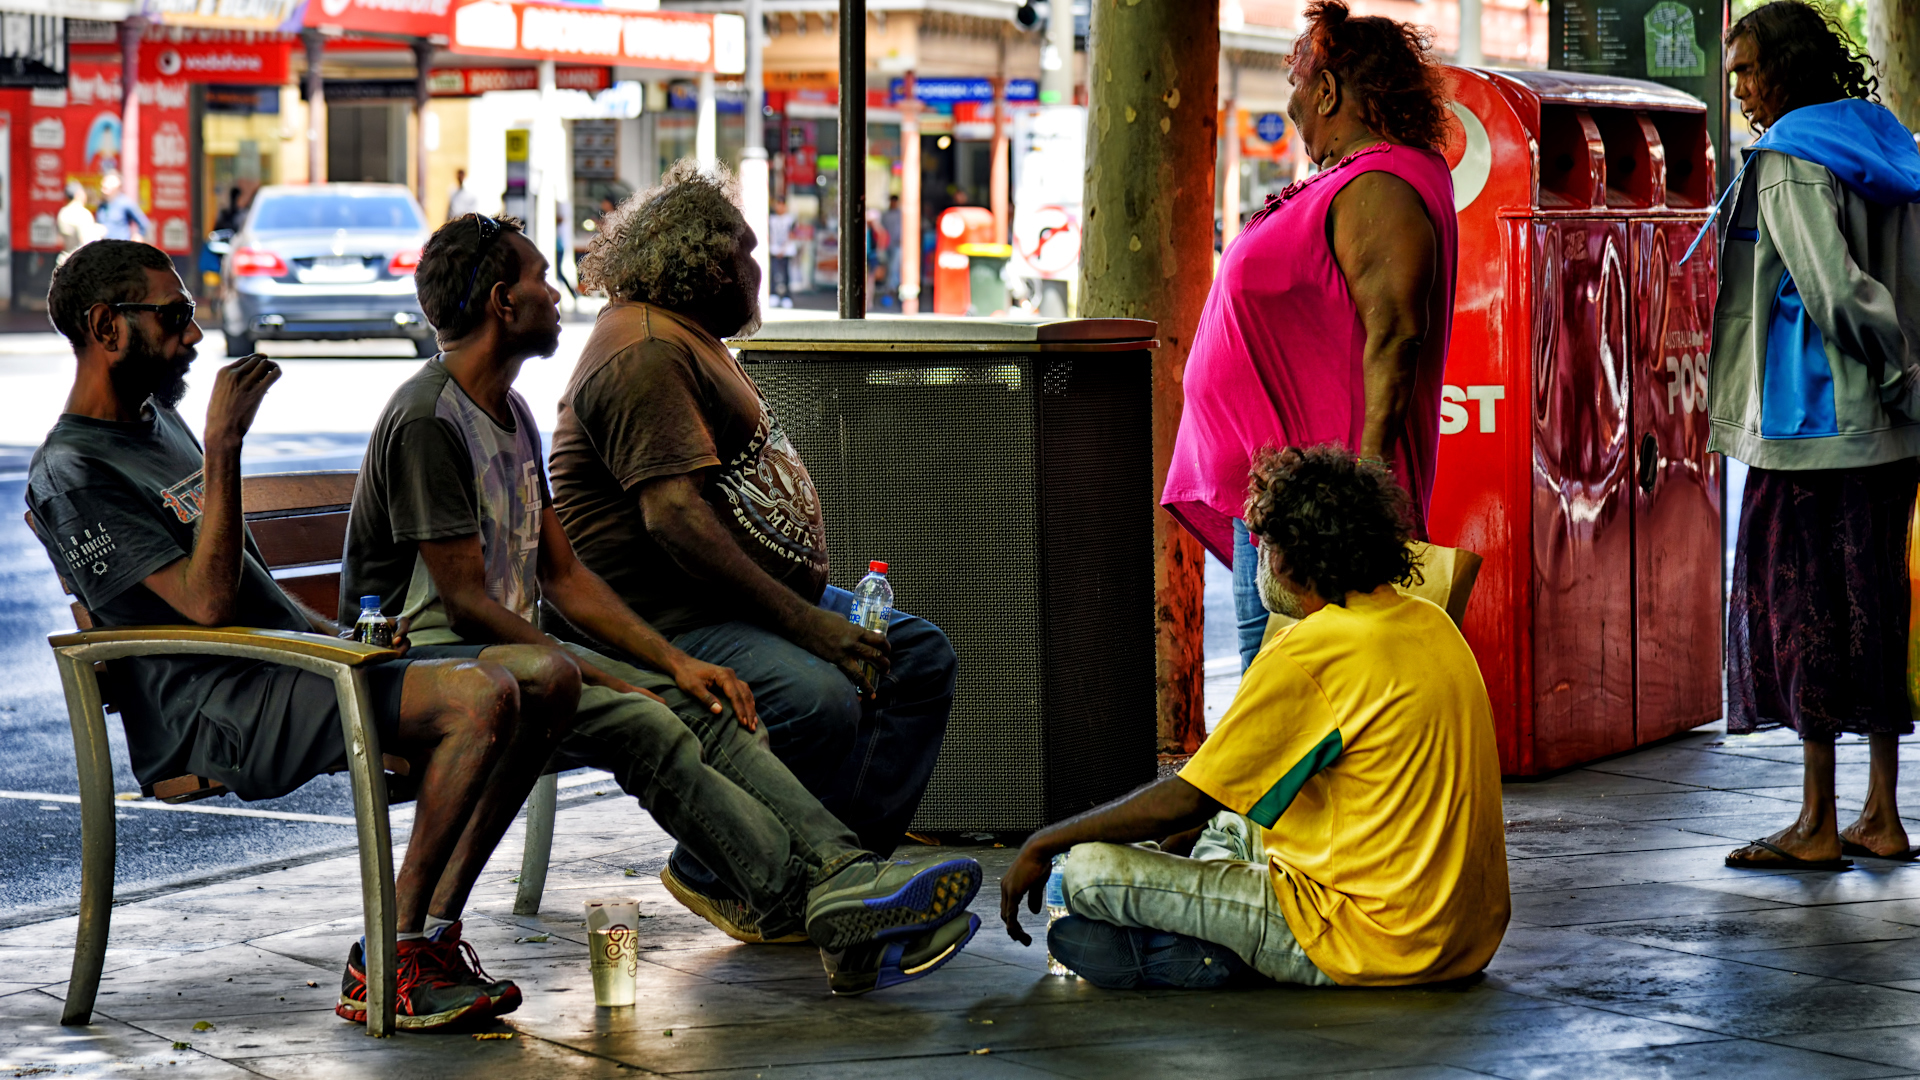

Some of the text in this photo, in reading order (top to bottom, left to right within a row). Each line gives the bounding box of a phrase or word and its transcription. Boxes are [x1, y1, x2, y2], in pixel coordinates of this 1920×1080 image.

[1665, 330, 1692, 349] AUSTRALIA
[1666, 352, 1709, 415] POS
[1439, 385, 1505, 435] ST
[65, 533, 112, 563] LOS ANGELES
